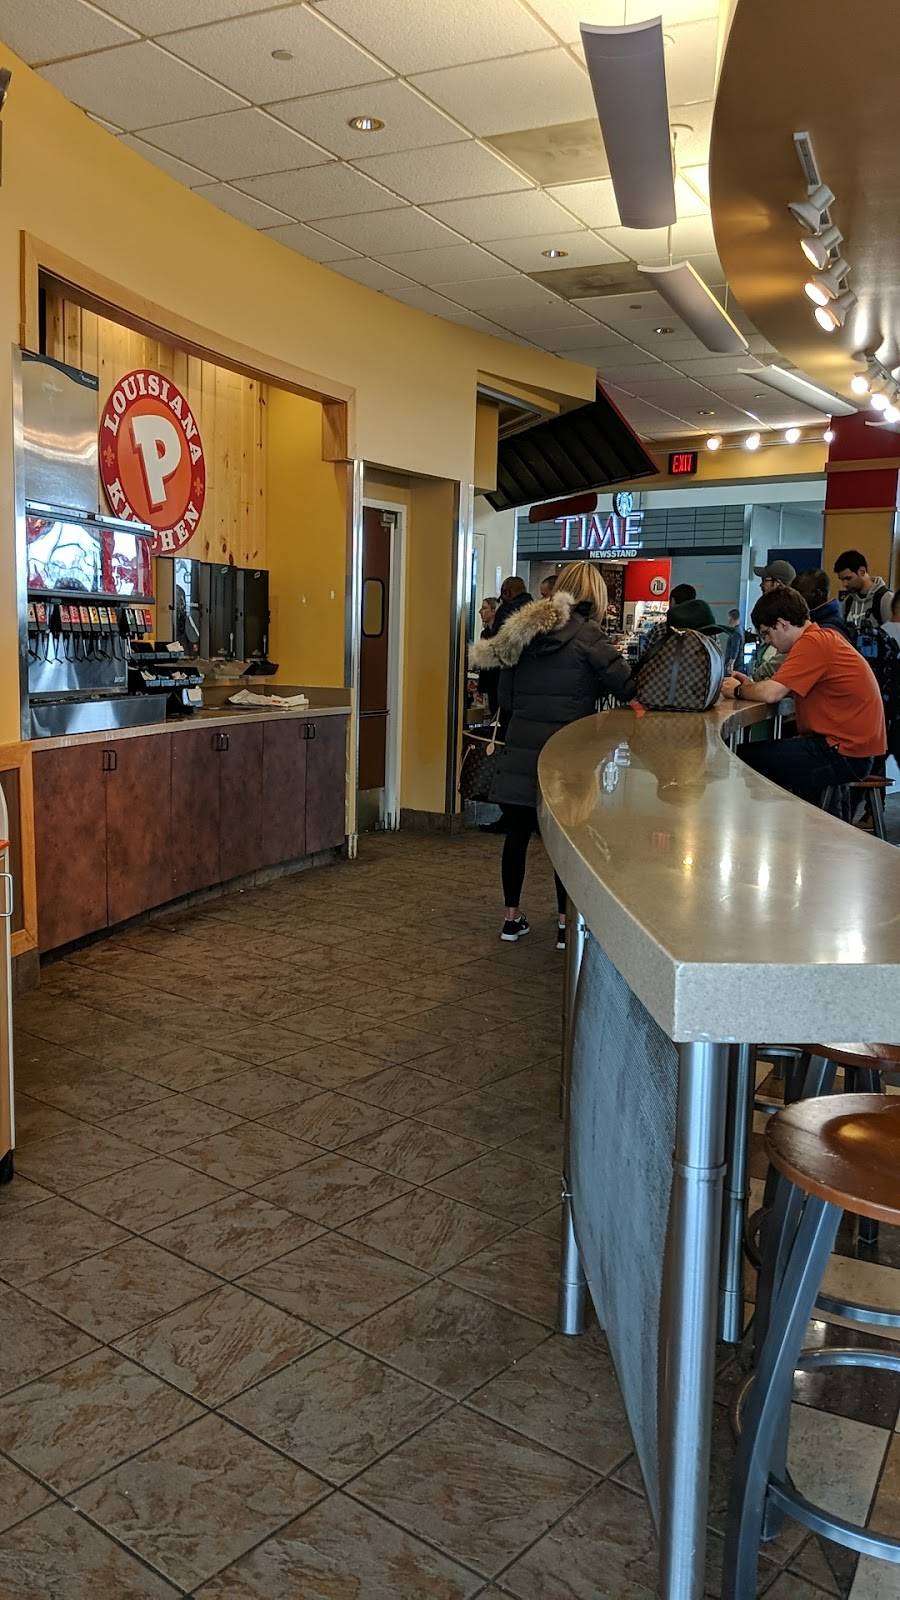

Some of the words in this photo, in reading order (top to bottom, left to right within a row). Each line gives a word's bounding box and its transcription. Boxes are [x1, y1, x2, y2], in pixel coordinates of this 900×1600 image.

[104, 373, 203, 465] LOUISIANA
[131, 414, 182, 505] P
[672, 454, 693, 473] EXIT
[555, 511, 644, 550] TIME
[589, 549, 638, 559] NEWSSTAND
